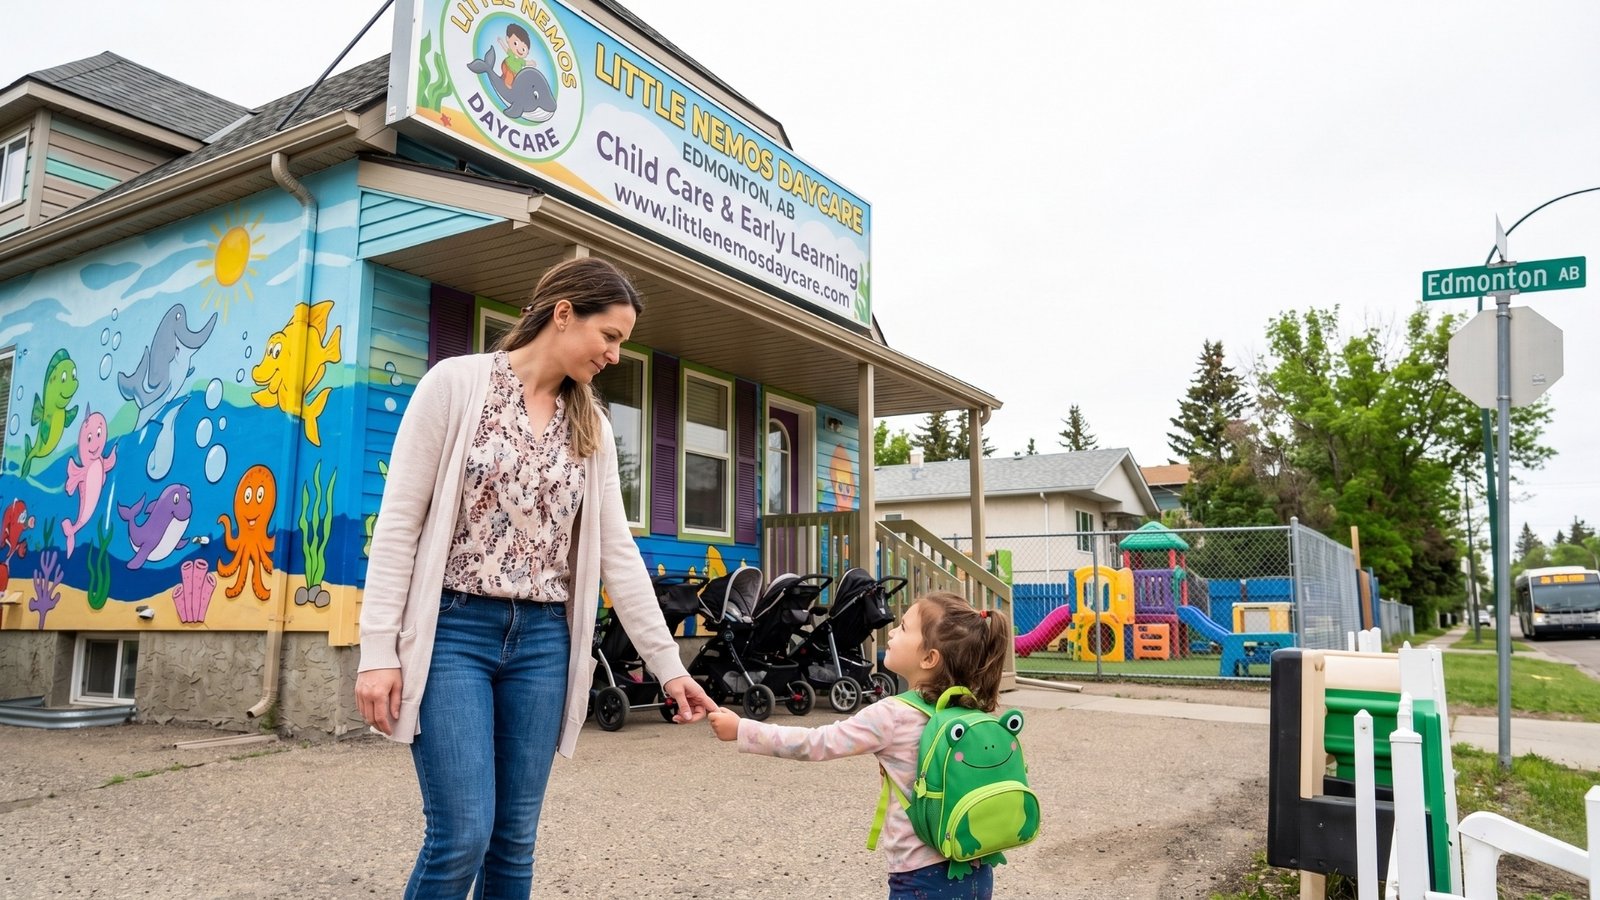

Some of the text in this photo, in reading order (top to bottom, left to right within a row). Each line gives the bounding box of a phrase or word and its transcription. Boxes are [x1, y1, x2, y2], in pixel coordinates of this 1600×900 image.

[520, 0, 577, 89] NEMOS
[467, 91, 560, 152] DAYCARE
[595, 41, 864, 236] LITTLE NEMOS DAYCARE
[596, 130, 858, 291] Child Care & Early Learning
[682, 141, 795, 220] EDMONTON, AB
[614, 182, 850, 309] www.littlenemosdaycare.com
[1427, 265, 1580, 296] Edmonton AB
